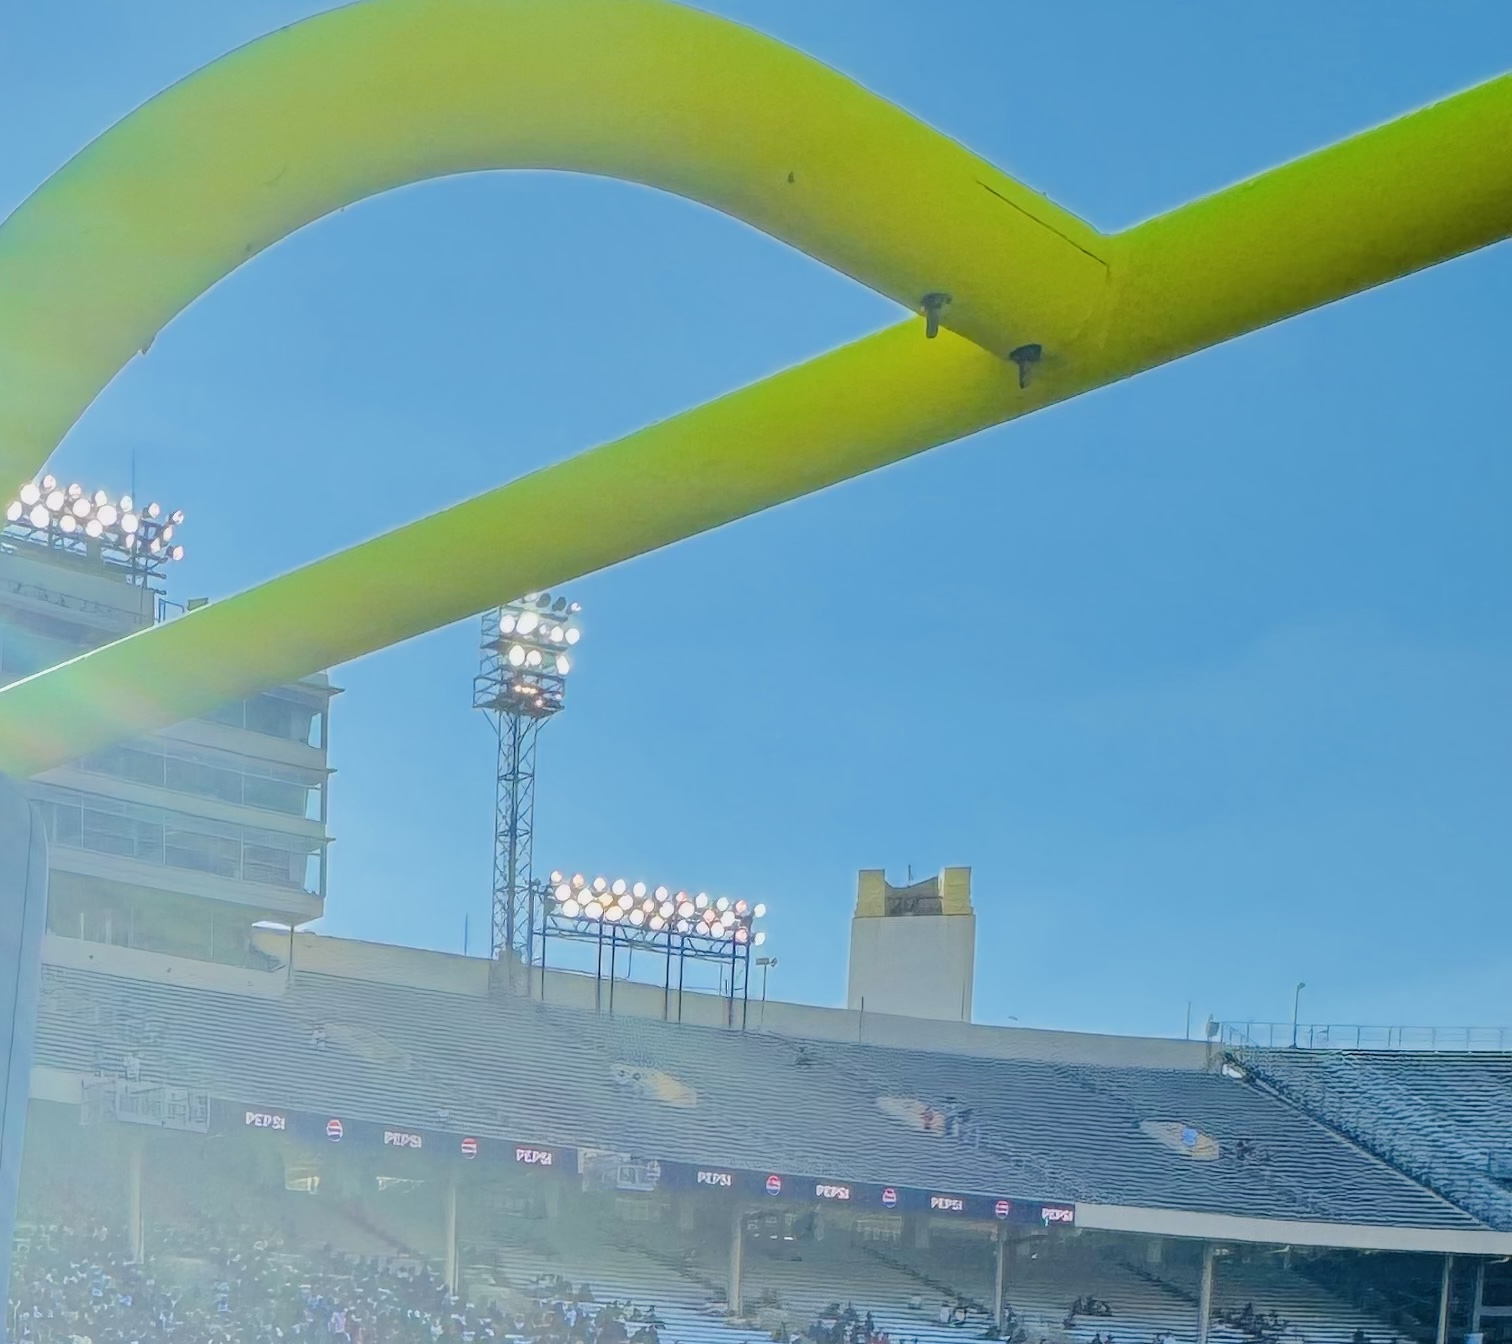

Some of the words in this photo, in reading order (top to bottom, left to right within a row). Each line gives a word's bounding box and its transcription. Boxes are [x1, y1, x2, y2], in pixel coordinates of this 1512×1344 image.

[245, 1111, 286, 1131] PEPSI
[384, 1131, 422, 1148] PEPSI
[516, 1148, 553, 1166] PEPSI
[697, 1170, 732, 1187] PEPSI
[816, 1184, 850, 1200] PEPSI
[930, 1196, 963, 1212] PEPSI
[1041, 1207, 1074, 1223] PEPSI
